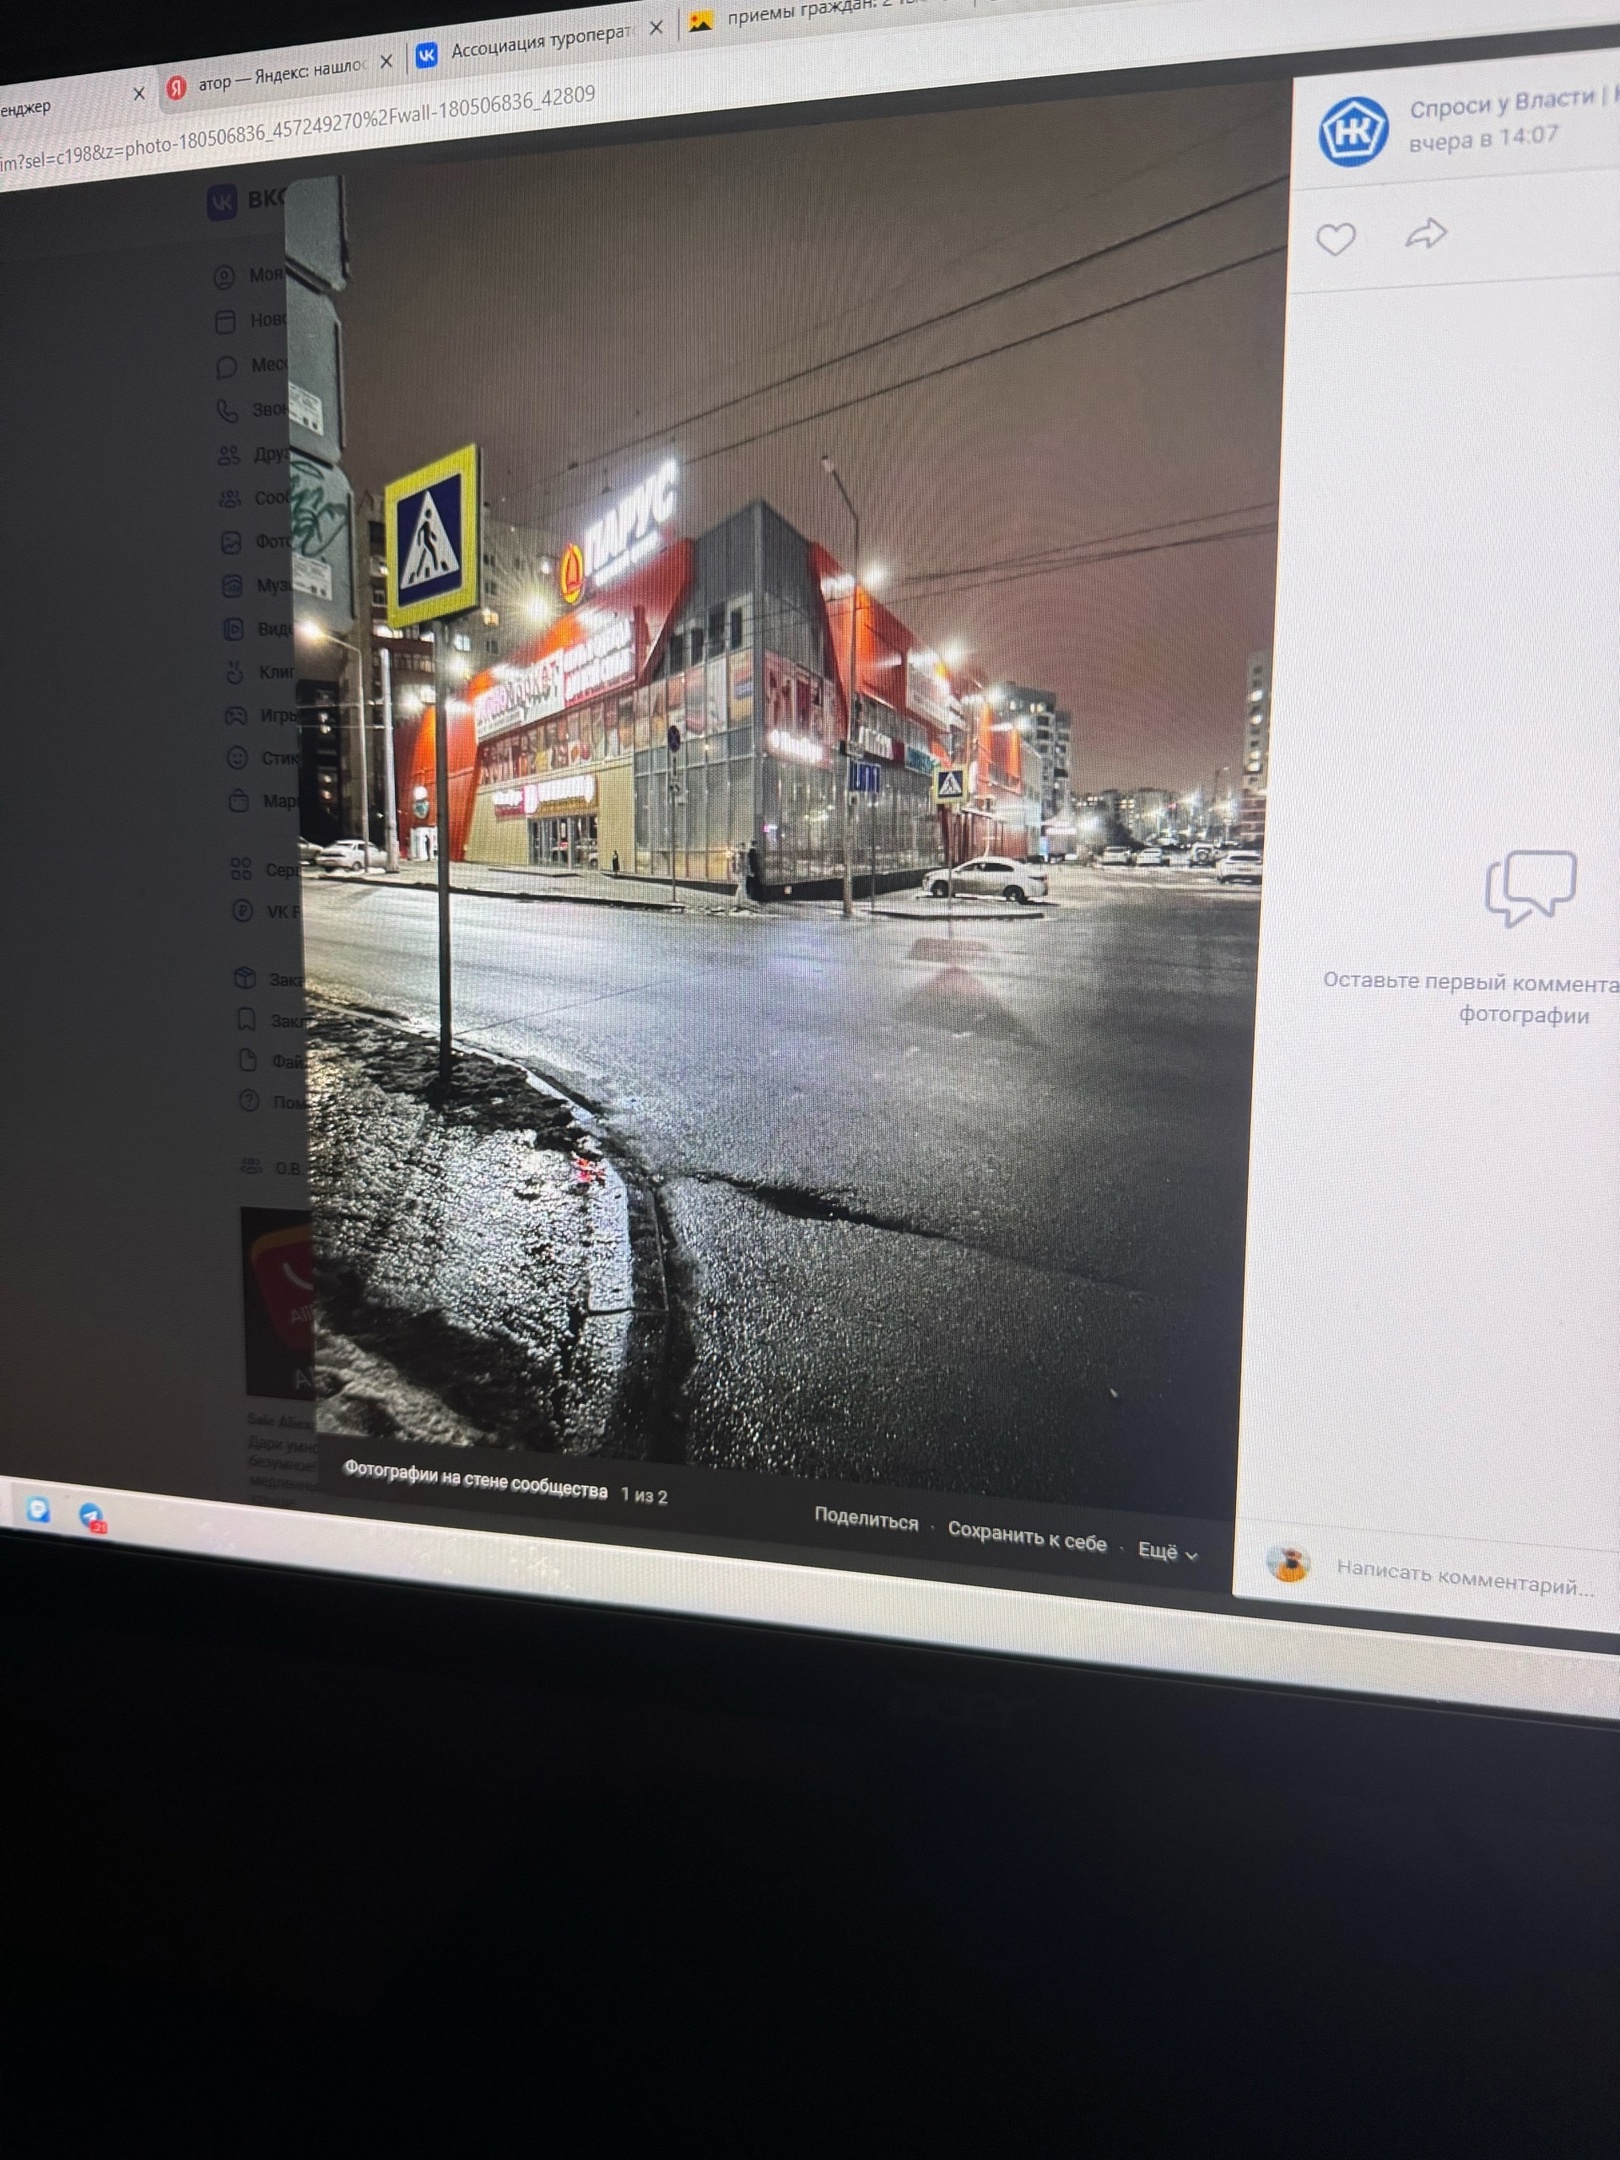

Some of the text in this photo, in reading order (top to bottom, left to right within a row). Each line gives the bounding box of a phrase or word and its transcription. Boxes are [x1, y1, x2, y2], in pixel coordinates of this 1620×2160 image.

[728, 8, 795, 28] приемы
[451, 36, 545, 59] Ассоциация
[199, 77, 231, 92] атор
[255, 67, 309, 84] Яндекс:
[1, 101, 51, 118] енджер
[1411, 98, 1490, 122] Спроси
[1497, 97, 1509, 115] у
[1516, 89, 1595, 111] Власти
[1410, 124, 1560, 154] вчера в 14:07
[250, 267, 283, 283] Моя
[1323, 971, 1420, 989] Оставьте
[1425, 973, 1506, 995] первый
[1460, 1004, 1590, 1028] фотографии
[345, 1459, 669, 1505] Фотографии на стене сообщества 1 из 2
[815, 1506, 1178, 1561] Поделиться Сохранить к себе Ещё
[1337, 1558, 1595, 1598] Написать комментарий...
